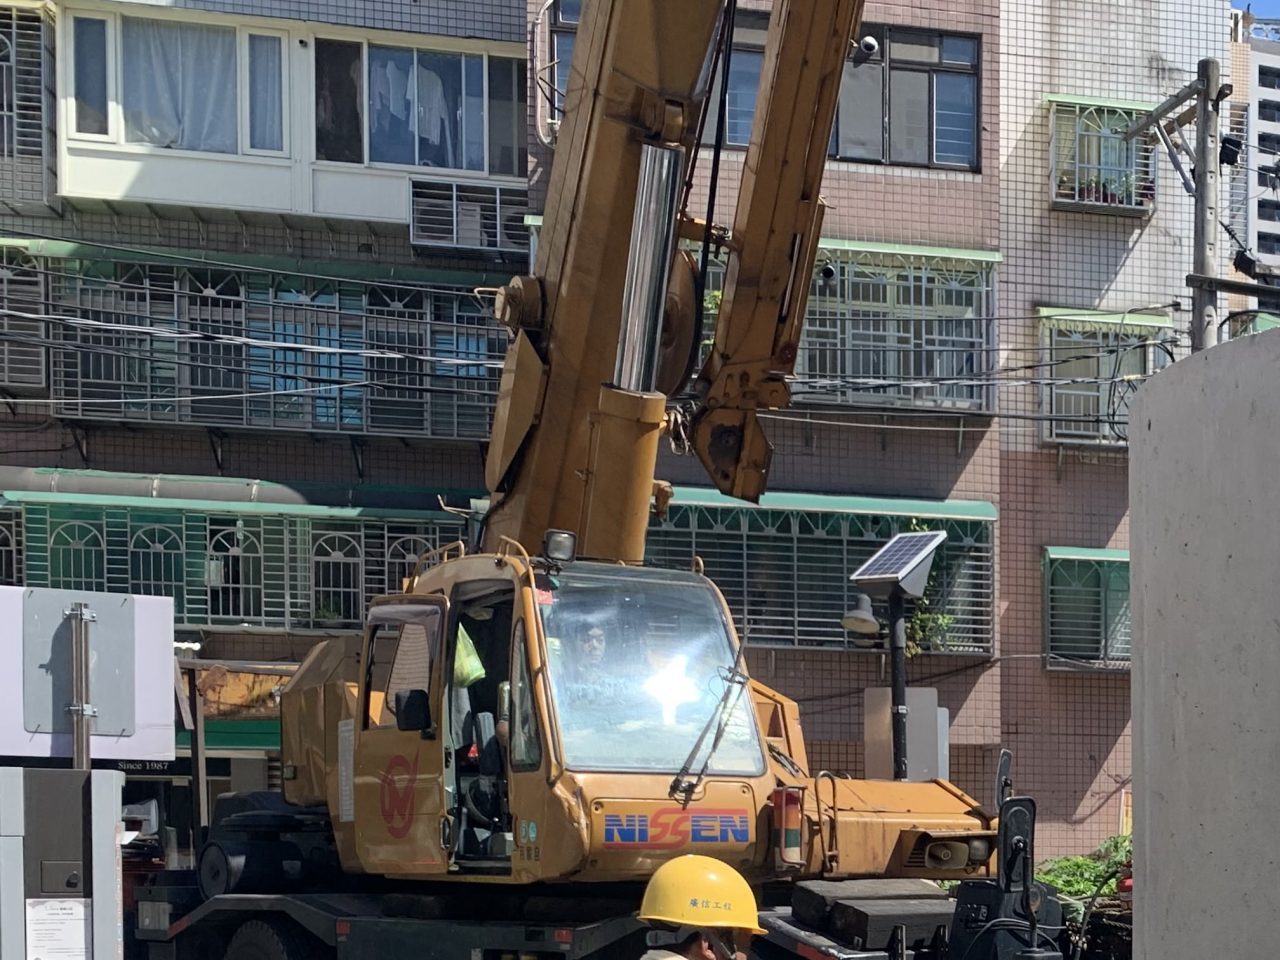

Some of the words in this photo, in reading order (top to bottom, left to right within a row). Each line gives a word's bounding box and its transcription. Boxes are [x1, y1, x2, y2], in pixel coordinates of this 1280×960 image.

[118, 762, 141, 770] Since
[146, 762, 168, 770] 1987
[603, 808, 749, 849] NISSEN
